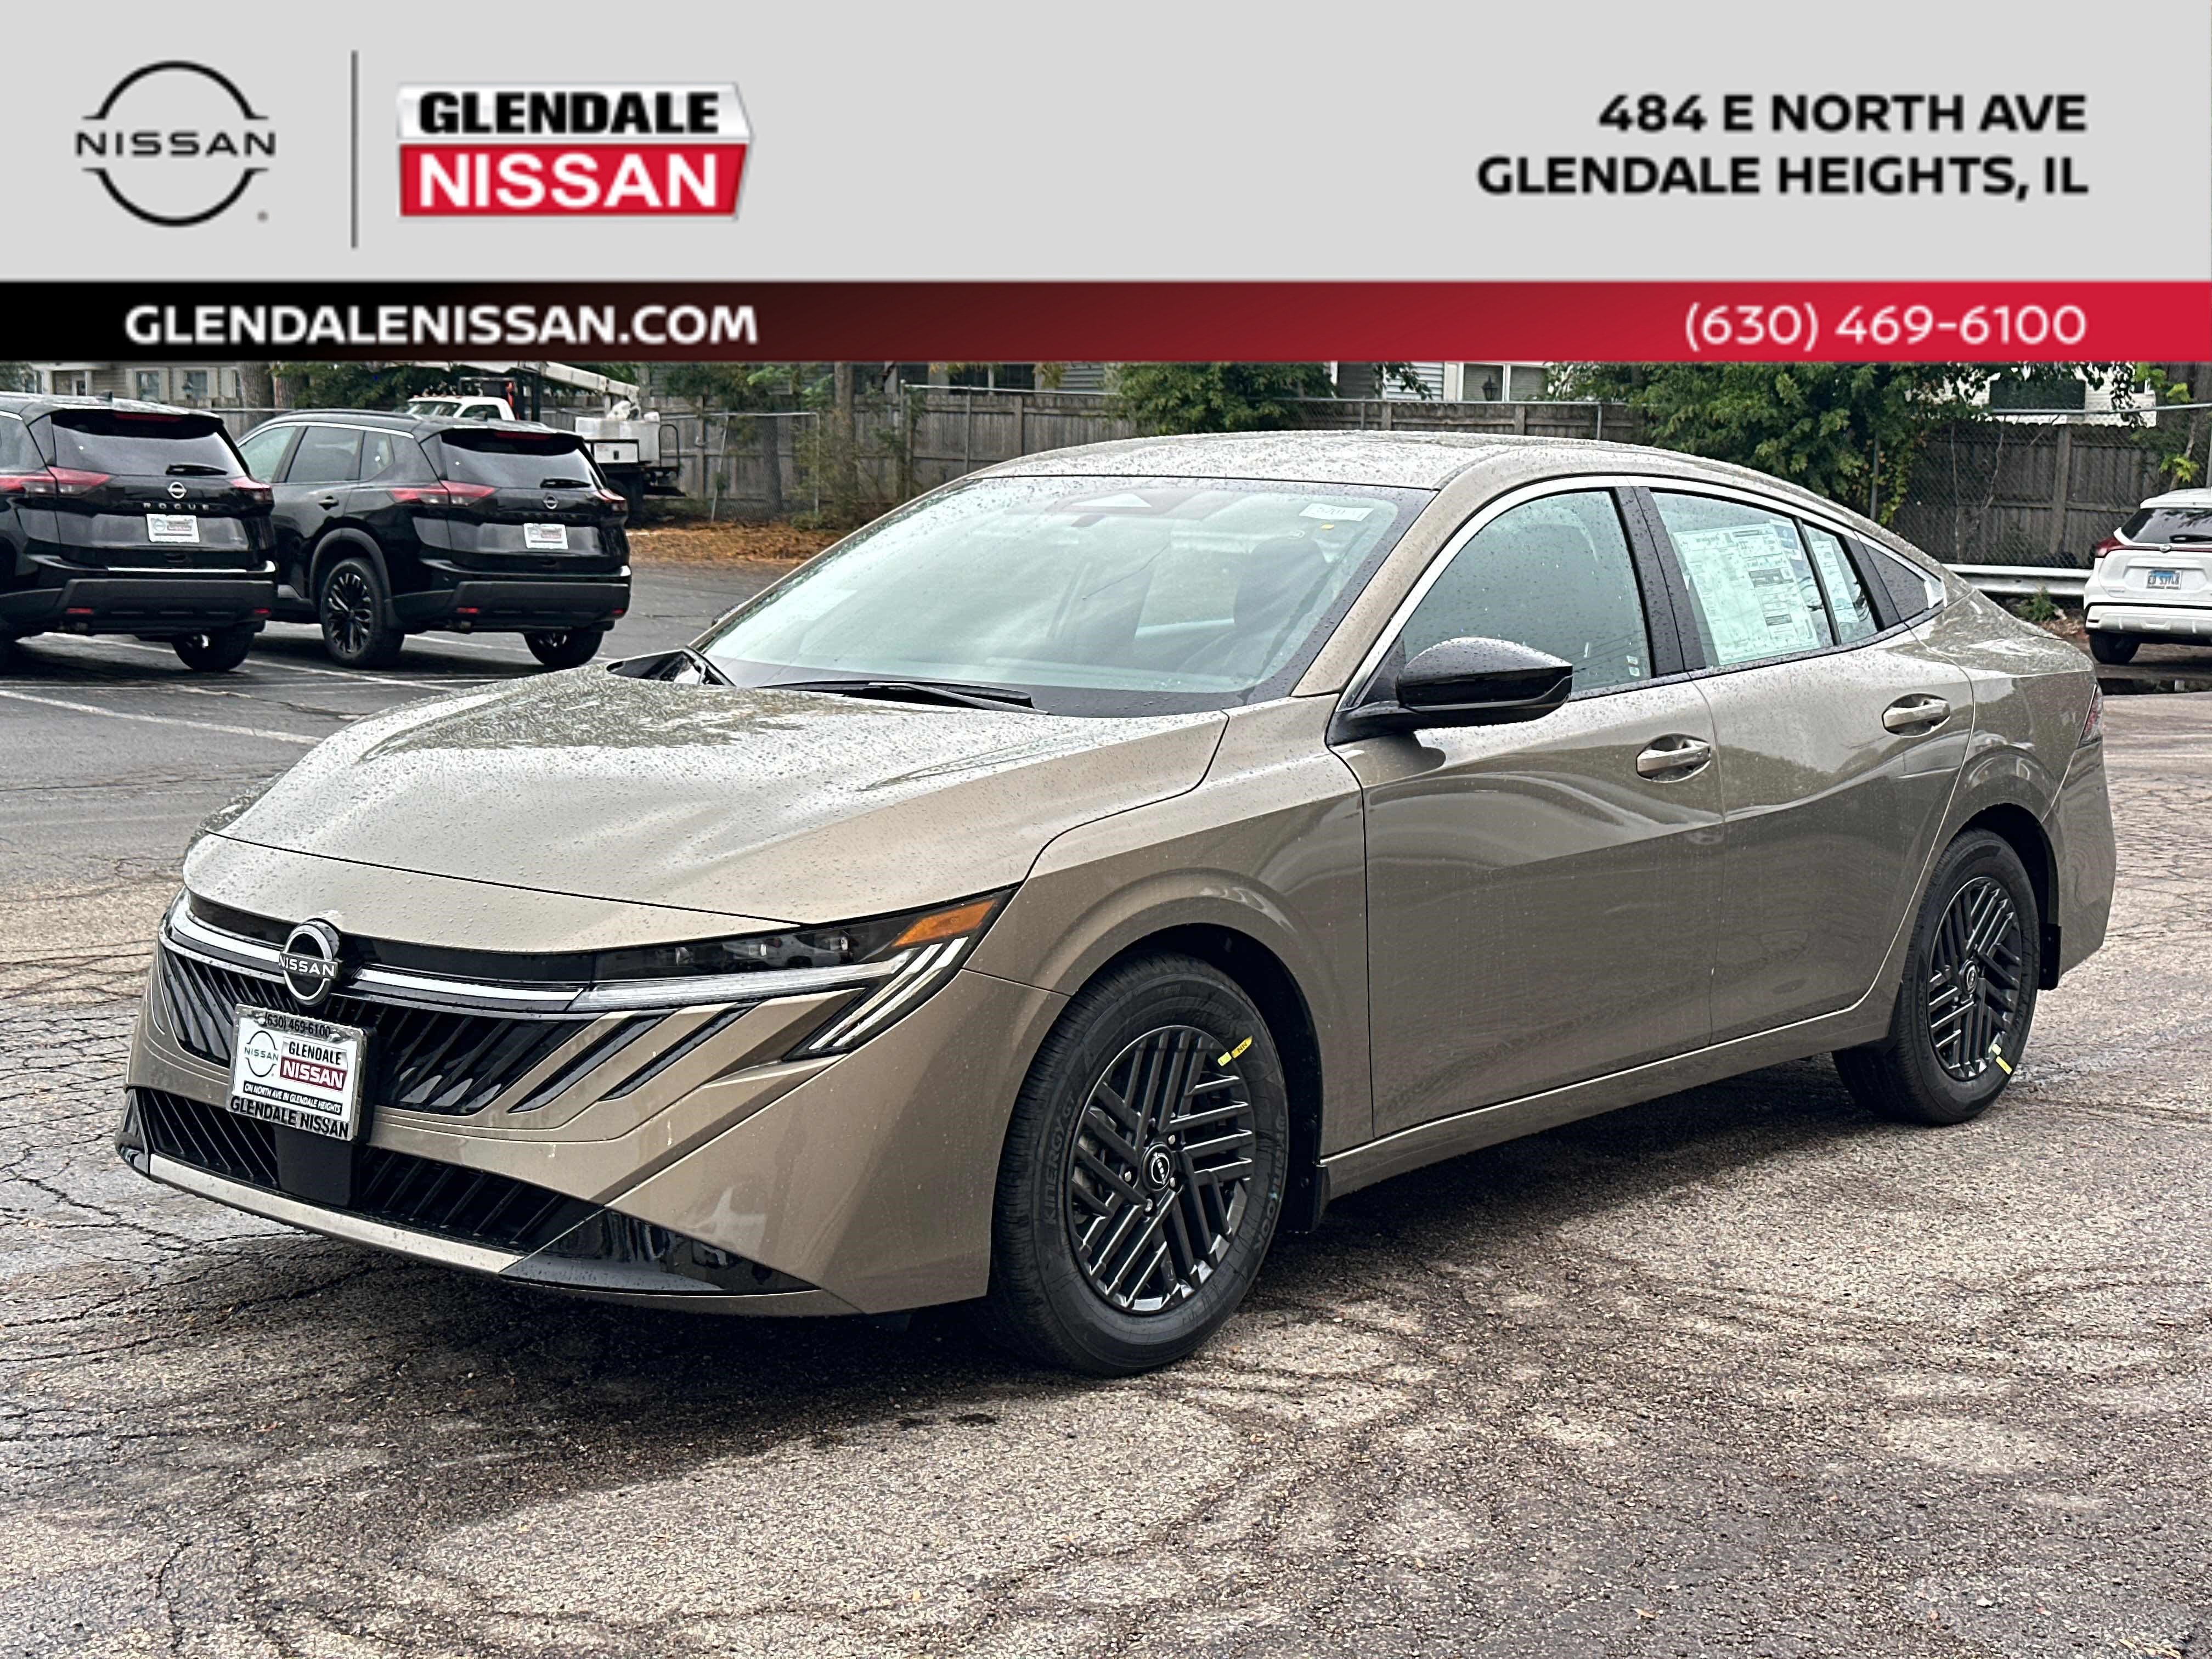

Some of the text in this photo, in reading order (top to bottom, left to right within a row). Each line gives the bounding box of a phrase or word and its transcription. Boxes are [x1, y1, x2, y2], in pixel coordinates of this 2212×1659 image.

[142, 502, 210, 511] ROGUE
[279, 955, 335, 977] NISSAN
[265, 1013, 330, 1038] (630) 469-6100
[244, 1046, 279, 1062] NISSAN
[289, 1041, 343, 1065] GLENDALE
[283, 1060, 344, 1088] NISSAN
[245, 1083, 341, 1114] ON NORTH AVE IN GLENDALE HEIGHTS
[230, 1096, 349, 1138] GLENDALE NISSAN
[1043, 1115, 1065, 1225] KINERGY
